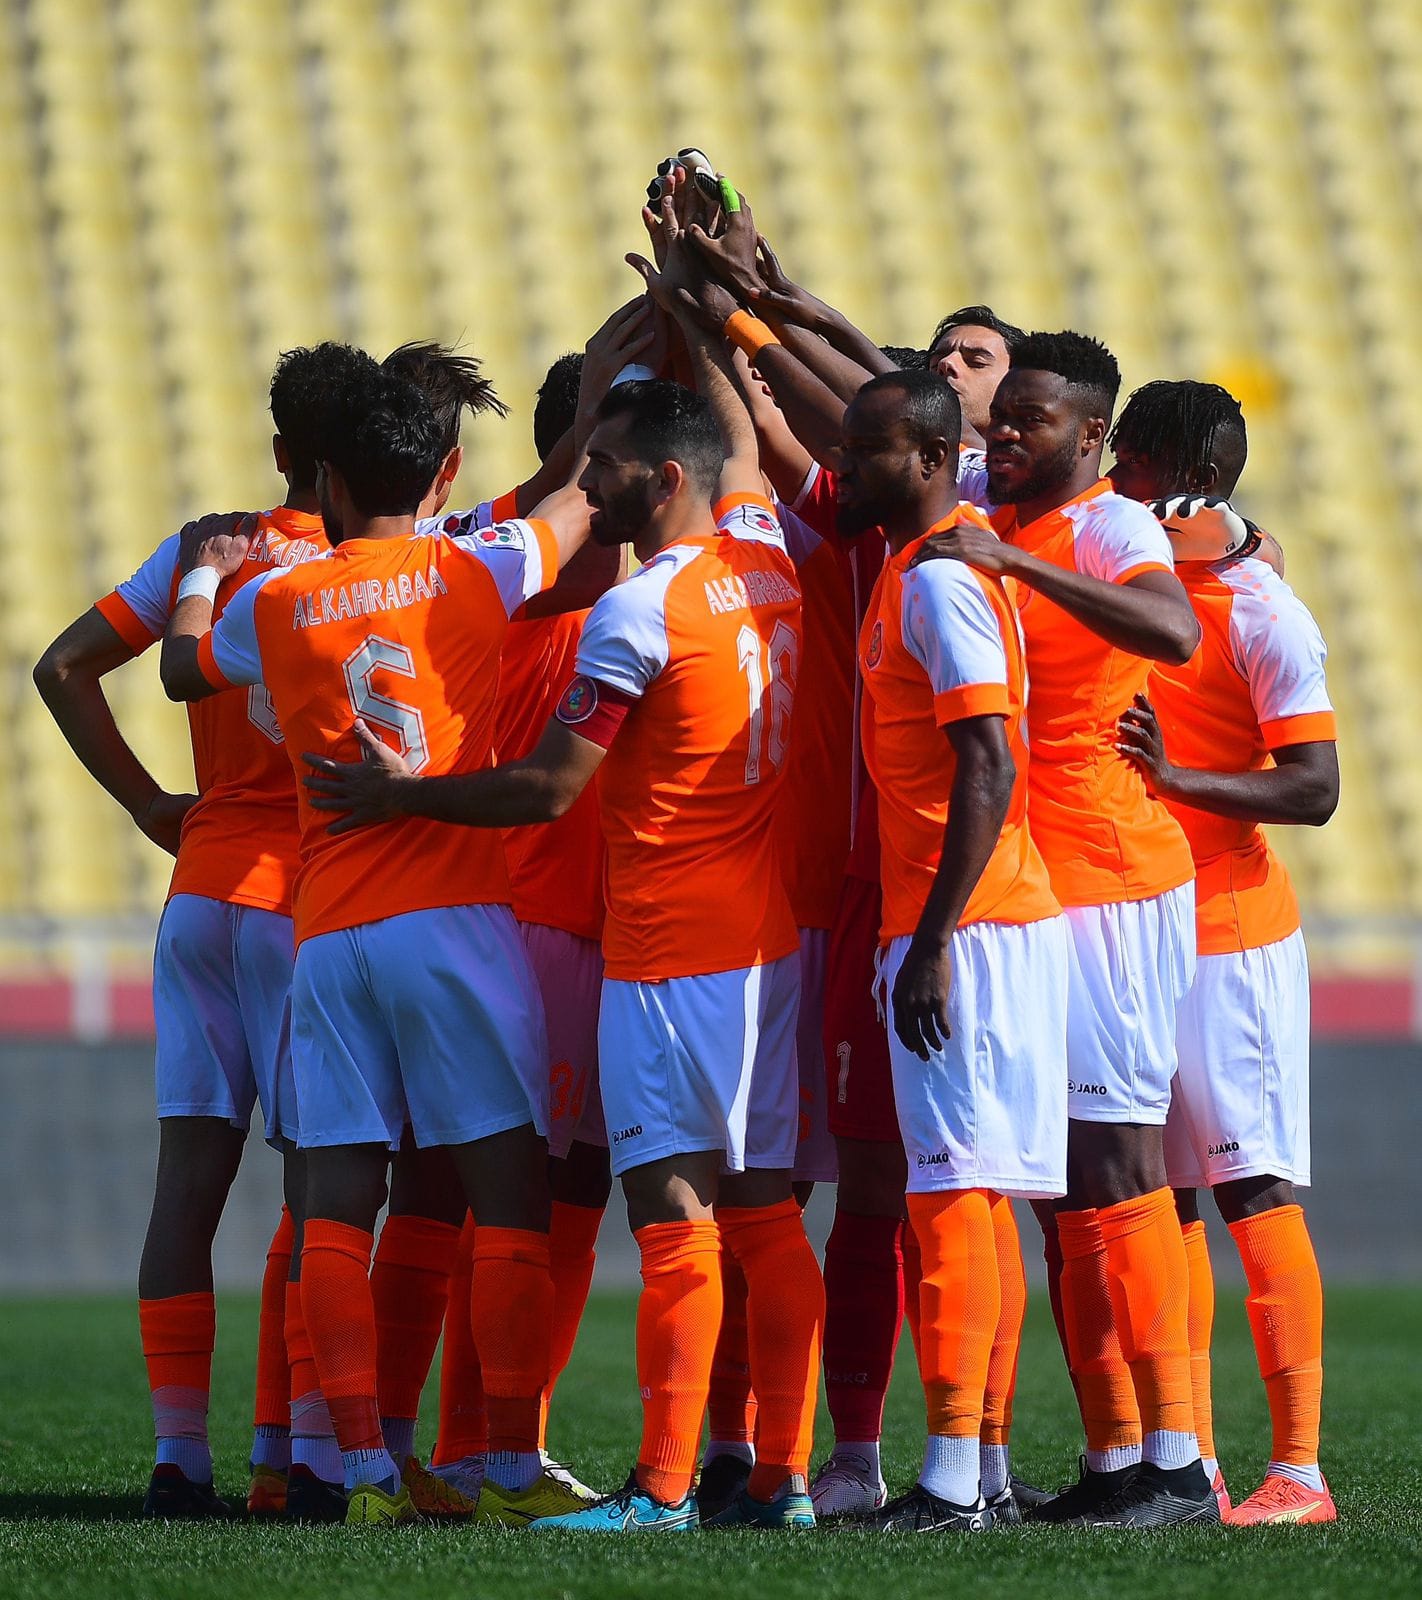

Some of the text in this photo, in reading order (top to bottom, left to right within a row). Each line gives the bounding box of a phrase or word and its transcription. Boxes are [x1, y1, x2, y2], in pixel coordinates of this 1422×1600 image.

[736, 618, 798, 785] 16
[836, 1040, 851, 1104] 1
[1077, 1083, 1107, 1095] JAKO
[620, 1125, 643, 1140] JAKO
[1214, 1141, 1240, 1155] JAKO
[926, 1152, 949, 1165] JAKO
